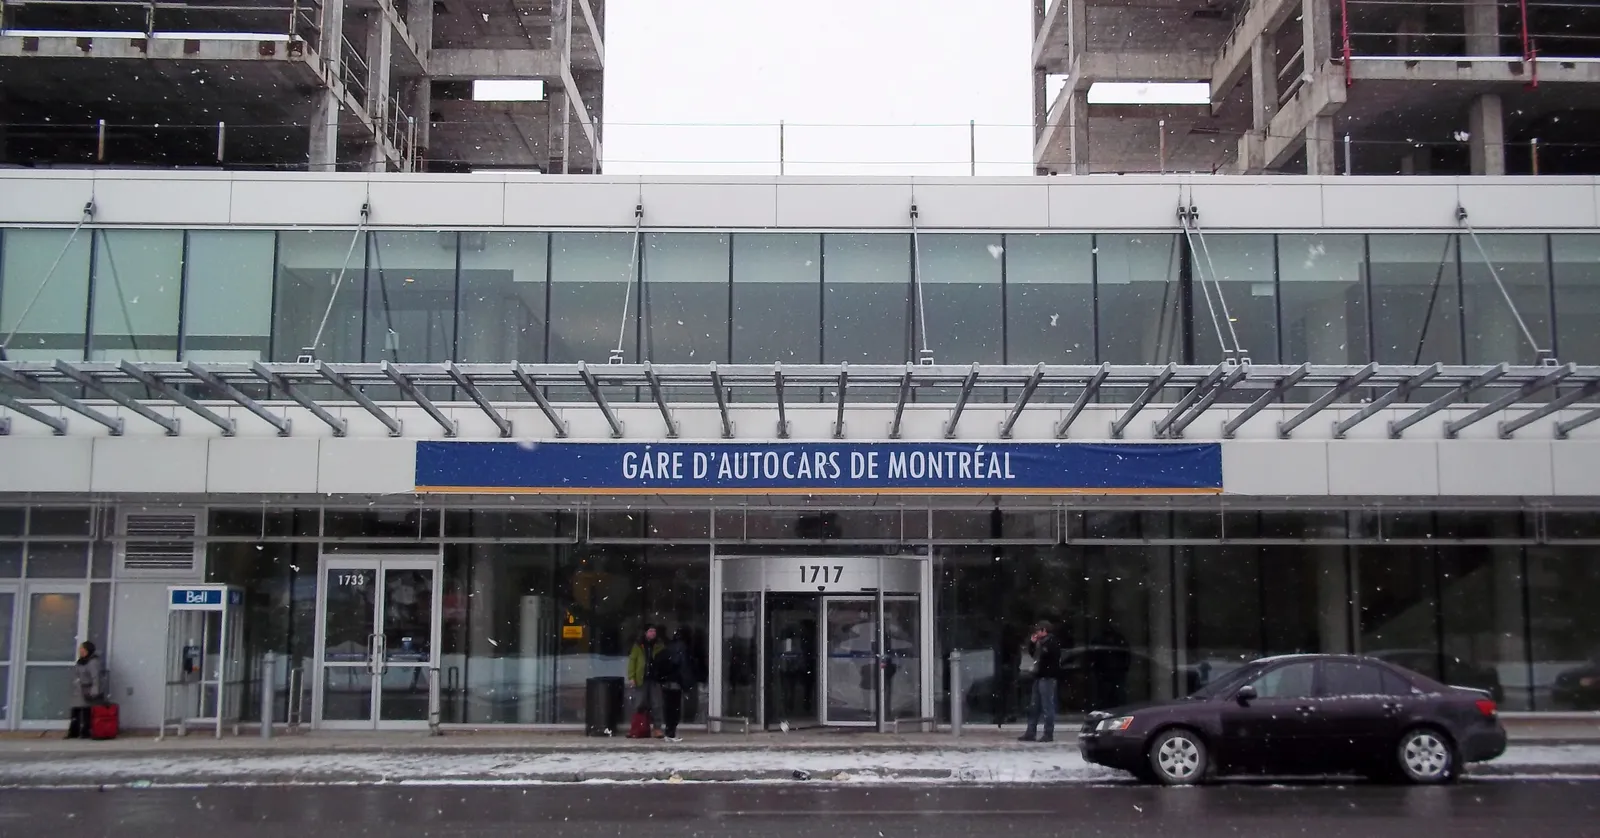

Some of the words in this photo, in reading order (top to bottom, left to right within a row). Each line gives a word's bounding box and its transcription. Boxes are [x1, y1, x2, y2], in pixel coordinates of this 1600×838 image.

[622, 452, 684, 479] GARE
[850, 452, 879, 479] DE
[888, 445, 1016, 479] MONTRÉAL
[338, 574, 364, 586] 1733
[799, 565, 844, 583] 1717
[186, 590, 208, 603] Bell
